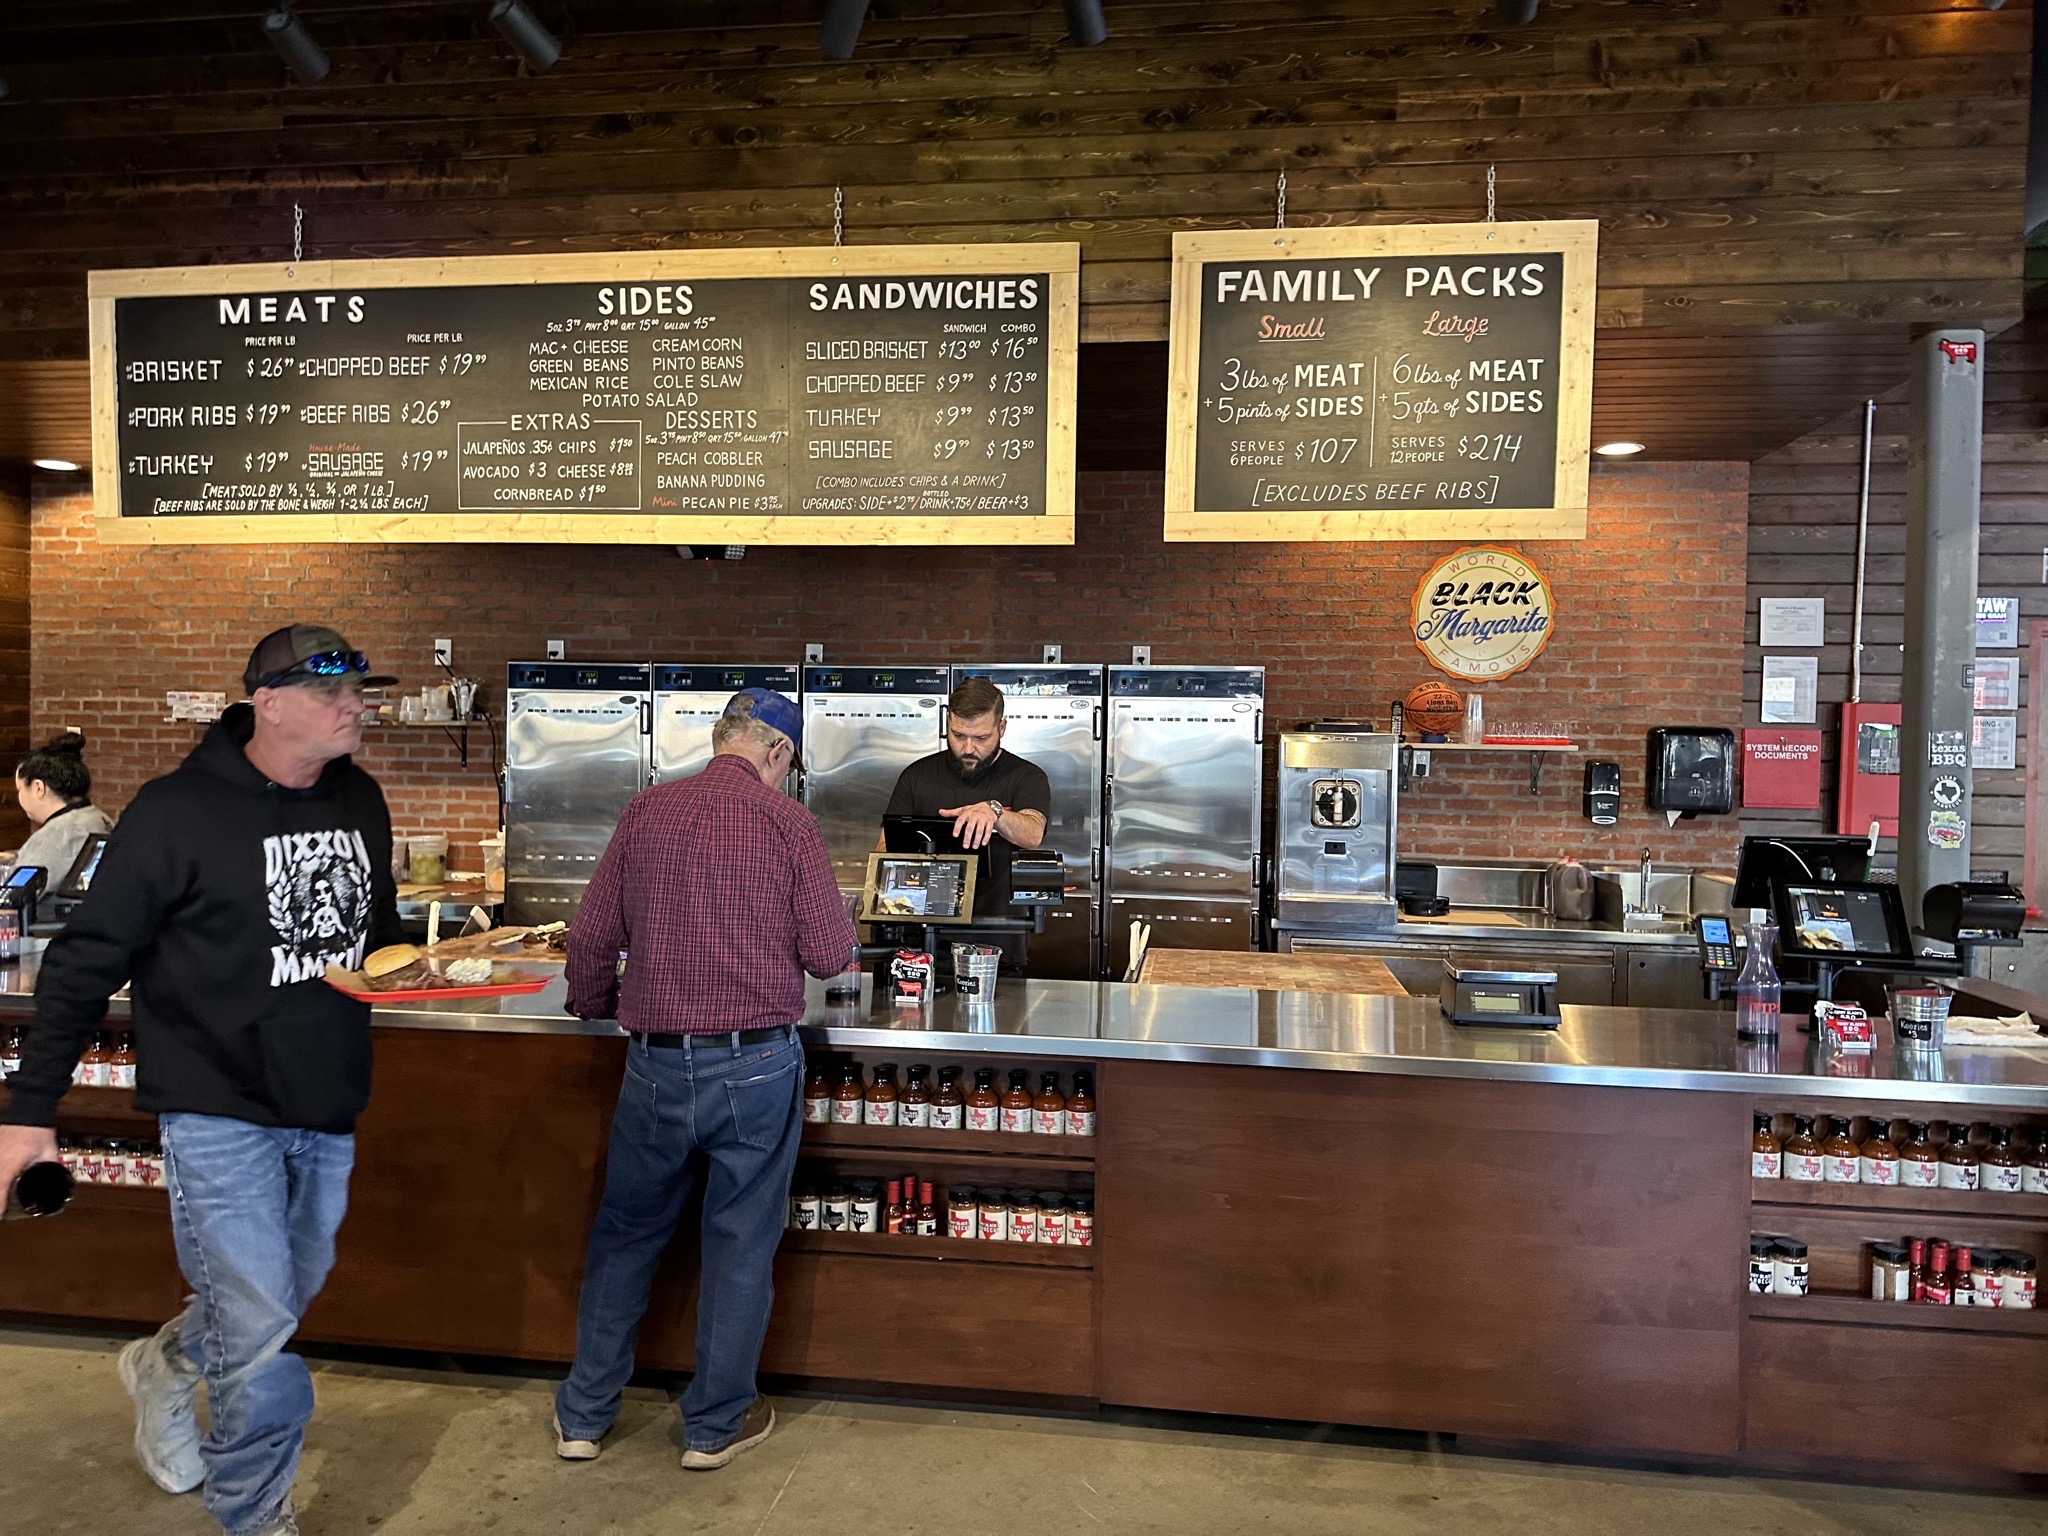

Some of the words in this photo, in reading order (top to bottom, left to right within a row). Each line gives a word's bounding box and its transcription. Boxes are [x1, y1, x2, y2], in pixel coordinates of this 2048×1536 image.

[1217, 267, 1381, 303] FAMILY
[1405, 262, 1545, 298] PACKS
[597, 285, 694, 316] SIDES
[809, 278, 1038, 311] SANDWICHES
[219, 296, 365, 324] MEATS
[943, 324, 987, 334] SANDWICH
[1000, 323, 1036, 333] COMBO
[1258, 314, 1326, 339] Small
[1422, 310, 1489, 343] Large
[245, 337, 266, 347] PRICE
[268, 336, 282, 346] PER
[407, 333, 431, 343] PRICE
[434, 333, 449, 343] PER
[652, 338, 700, 352] CREAM
[702, 337, 743, 352] CORN
[529, 341, 559, 355] MAC
[573, 339, 629, 355] CHEESE
[806, 340, 860, 360] SLICED
[863, 340, 929, 360] BRISKET
[133, 360, 223, 382] BRISKET
[306, 356, 384, 377] CHOPPED
[389, 356, 430, 376] BEEF
[529, 359, 573, 373] GREEN
[583, 358, 629, 372] BEANS
[652, 356, 696, 372] PINTO
[701, 355, 744, 370] BEANS
[1392, 353, 1412, 383] 6
[1445, 368, 1462, 390] of
[1468, 358, 1545, 382] MEAT
[530, 376, 588, 391] MEXICAN
[595, 376, 629, 390] RICE
[653, 374, 694, 389] COLE
[700, 373, 743, 388] SLAW
[806, 374, 882, 394] CHOPPED
[885, 373, 926, 393] BEEF
[1220, 358, 1242, 392] 3
[1272, 372, 1289, 395] of
[1295, 362, 1365, 388] MEAT
[582, 393, 640, 408] POTATO
[645, 392, 699, 407] SALAD
[1392, 392, 1411, 420] 5
[1444, 398, 1460, 418] of
[1465, 389, 1544, 413] SIDES
[135, 407, 184, 428] PORK
[191, 405, 236, 426] RIBS
[306, 405, 347, 424] BEEF
[352, 404, 390, 423] RIBS
[805, 407, 881, 427] TURKEY
[1217, 397, 1234, 424] 5
[1235, 400, 1274, 424] pints
[1275, 401, 1291, 423] of
[1295, 395, 1364, 418] SIDES
[511, 412, 590, 431] EXTRAS
[666, 409, 758, 430] DESSERTS
[463, 438, 526, 455] JALAPEÑOS
[558, 440, 597, 454] CHIPS
[808, 439, 893, 459] SAUSAGE
[1230, 440, 1286, 452] SERVES
[1391, 436, 1446, 448] SERVES
[1457, 434, 1523, 464] $214
[657, 452, 697, 466] PEACH
[703, 451, 764, 466] COBBLER
[1294, 438, 1358, 464] $107
[135, 454, 214, 476] TURKEY
[308, 452, 384, 472] SAUSAGE
[463, 466, 520, 479] AVOCADO
[557, 463, 606, 479] CHEESE
[657, 474, 708, 489] BANANA
[711, 473, 765, 488] PUDDING
[859, 476, 905, 488] INCLUDES
[909, 475, 938, 487] CHIPS
[940, 475, 948, 486] &
[951, 476, 960, 487] A
[238, 485, 266, 498] SOLD
[268, 484, 283, 498] BY
[343, 484, 357, 496] OR
[493, 488, 574, 501] CORNBREAD
[1251, 478, 1369, 507] [EXCLUDES
[1375, 483, 1427, 500] BEEF
[1435, 475, 1500, 504] RIBS]
[183, 500, 204, 512] RIBS
[206, 499, 223, 511] ARE
[224, 499, 246, 511] SOLD
[247, 499, 258, 512] BY
[260, 499, 275, 511] THE
[277, 499, 301, 511] BONE
[310, 499, 335, 510] WEIGH
[371, 497, 389, 509] LBS
[652, 495, 678, 507] Mini
[682, 497, 726, 509] PECAN
[729, 498, 750, 509] PIE
[802, 497, 857, 511] UPGRADES:
[1449, 554, 1526, 577] WORLD
[1431, 581, 1540, 607] BLACK
[1416, 606, 1549, 646] Margarita
[1438, 644, 1531, 673] FAMOUS
[1936, 733, 1944, 744] I
[1745, 743, 1781, 753] SYSTEM
[1754, 752, 1809, 760] DOCUMENTS
[1932, 744, 1966, 753] texas
[1931, 753, 1967, 768] BBQ
[1900, 1021, 1928, 1032] Koozies
